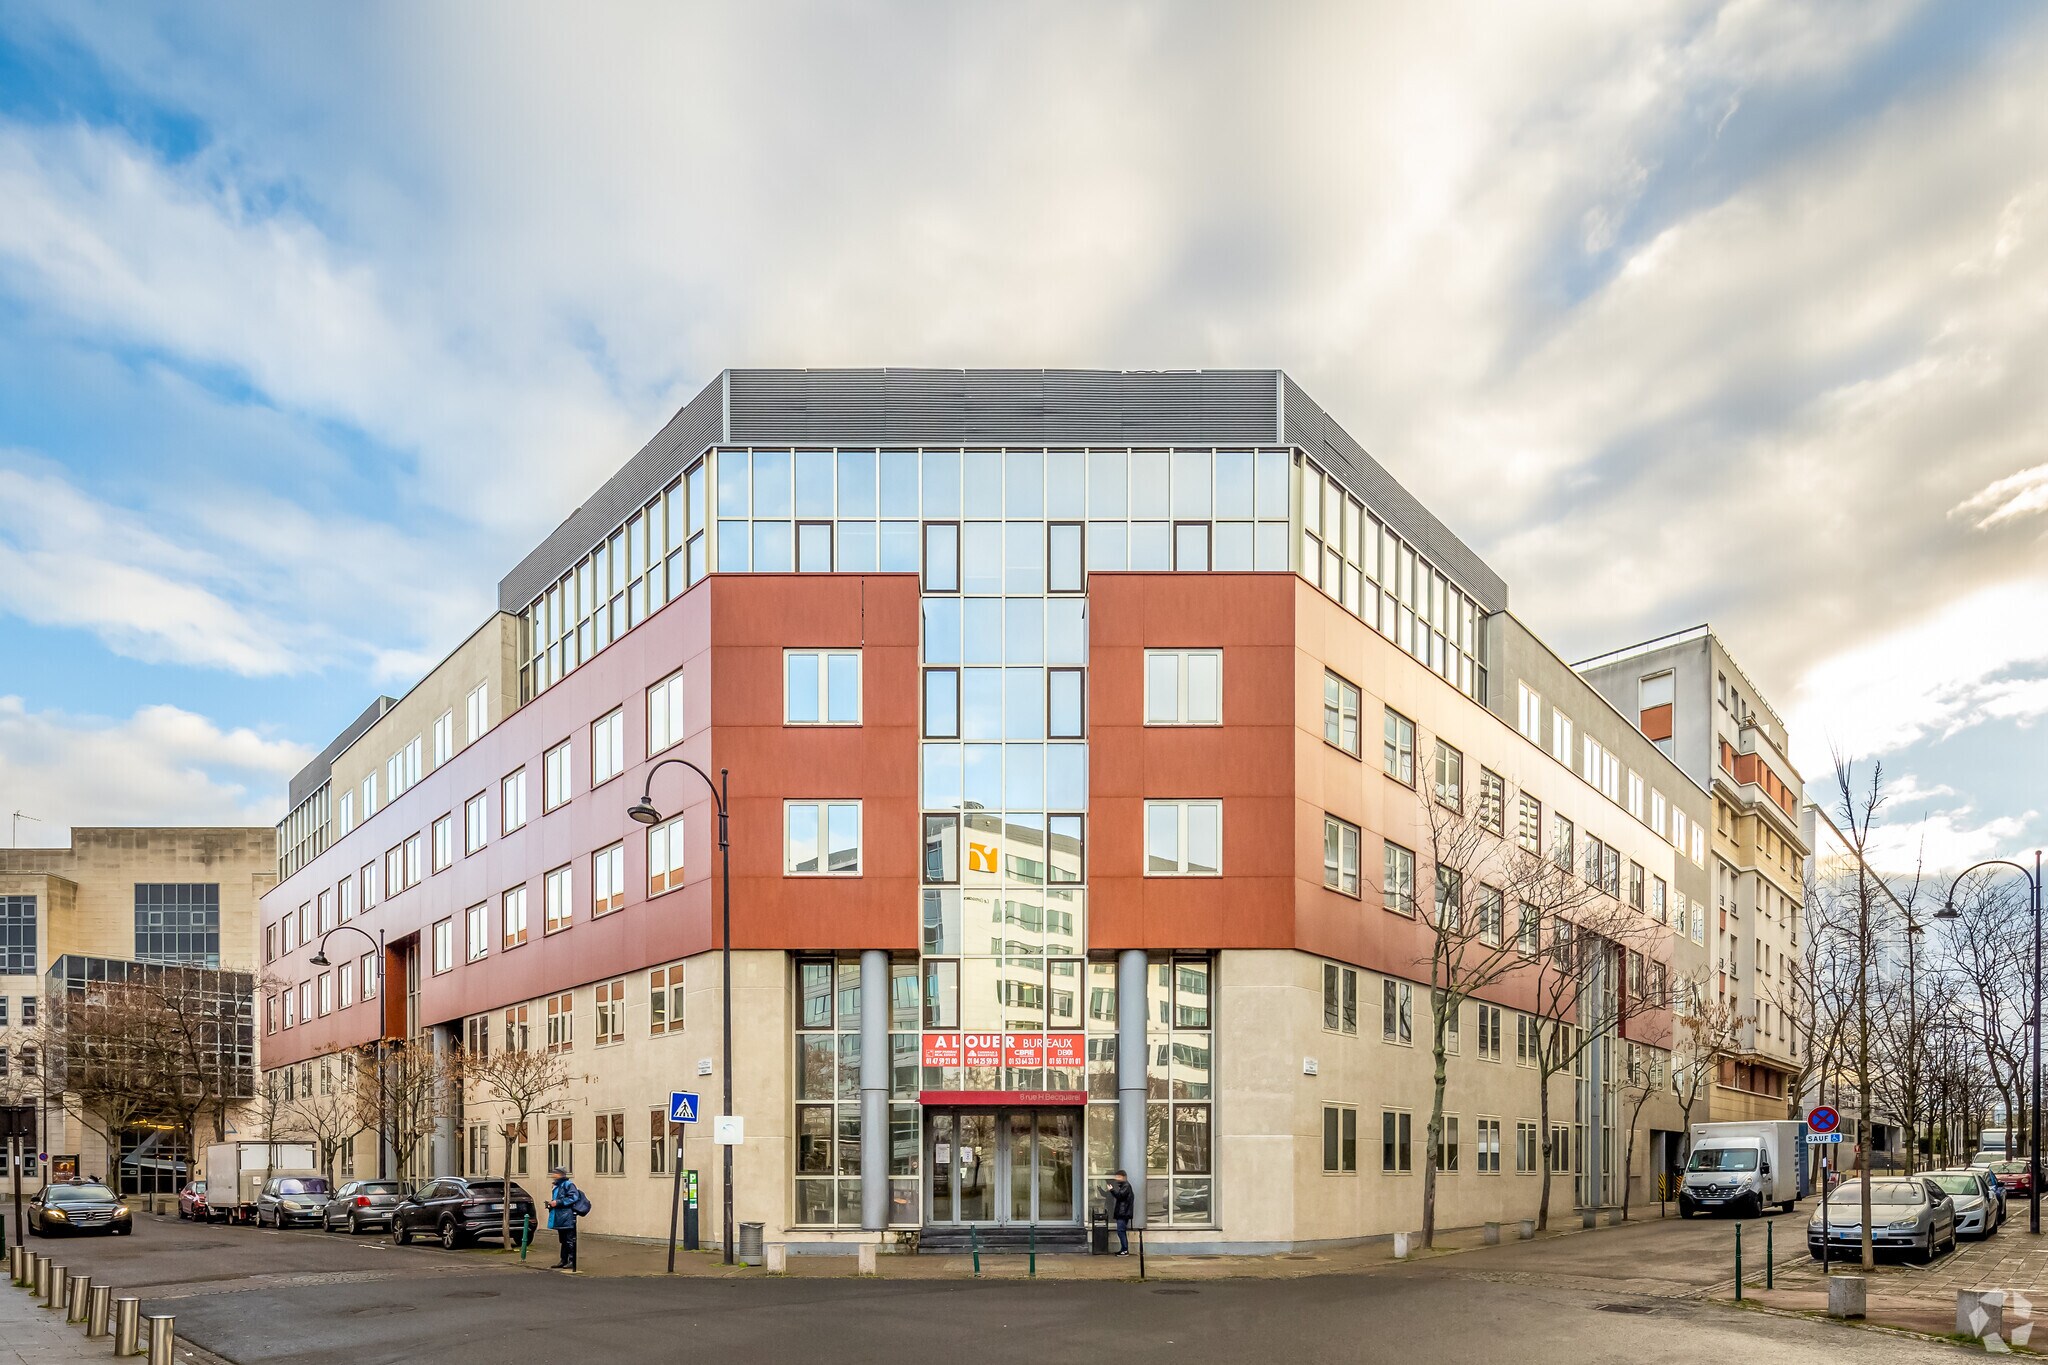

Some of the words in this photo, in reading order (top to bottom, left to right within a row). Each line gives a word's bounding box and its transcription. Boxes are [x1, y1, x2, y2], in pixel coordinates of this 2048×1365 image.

[934, 1035, 947, 1048] A
[952, 1035, 1015, 1049] LOUER
[1023, 1038, 1072, 1048] BUREAUX
